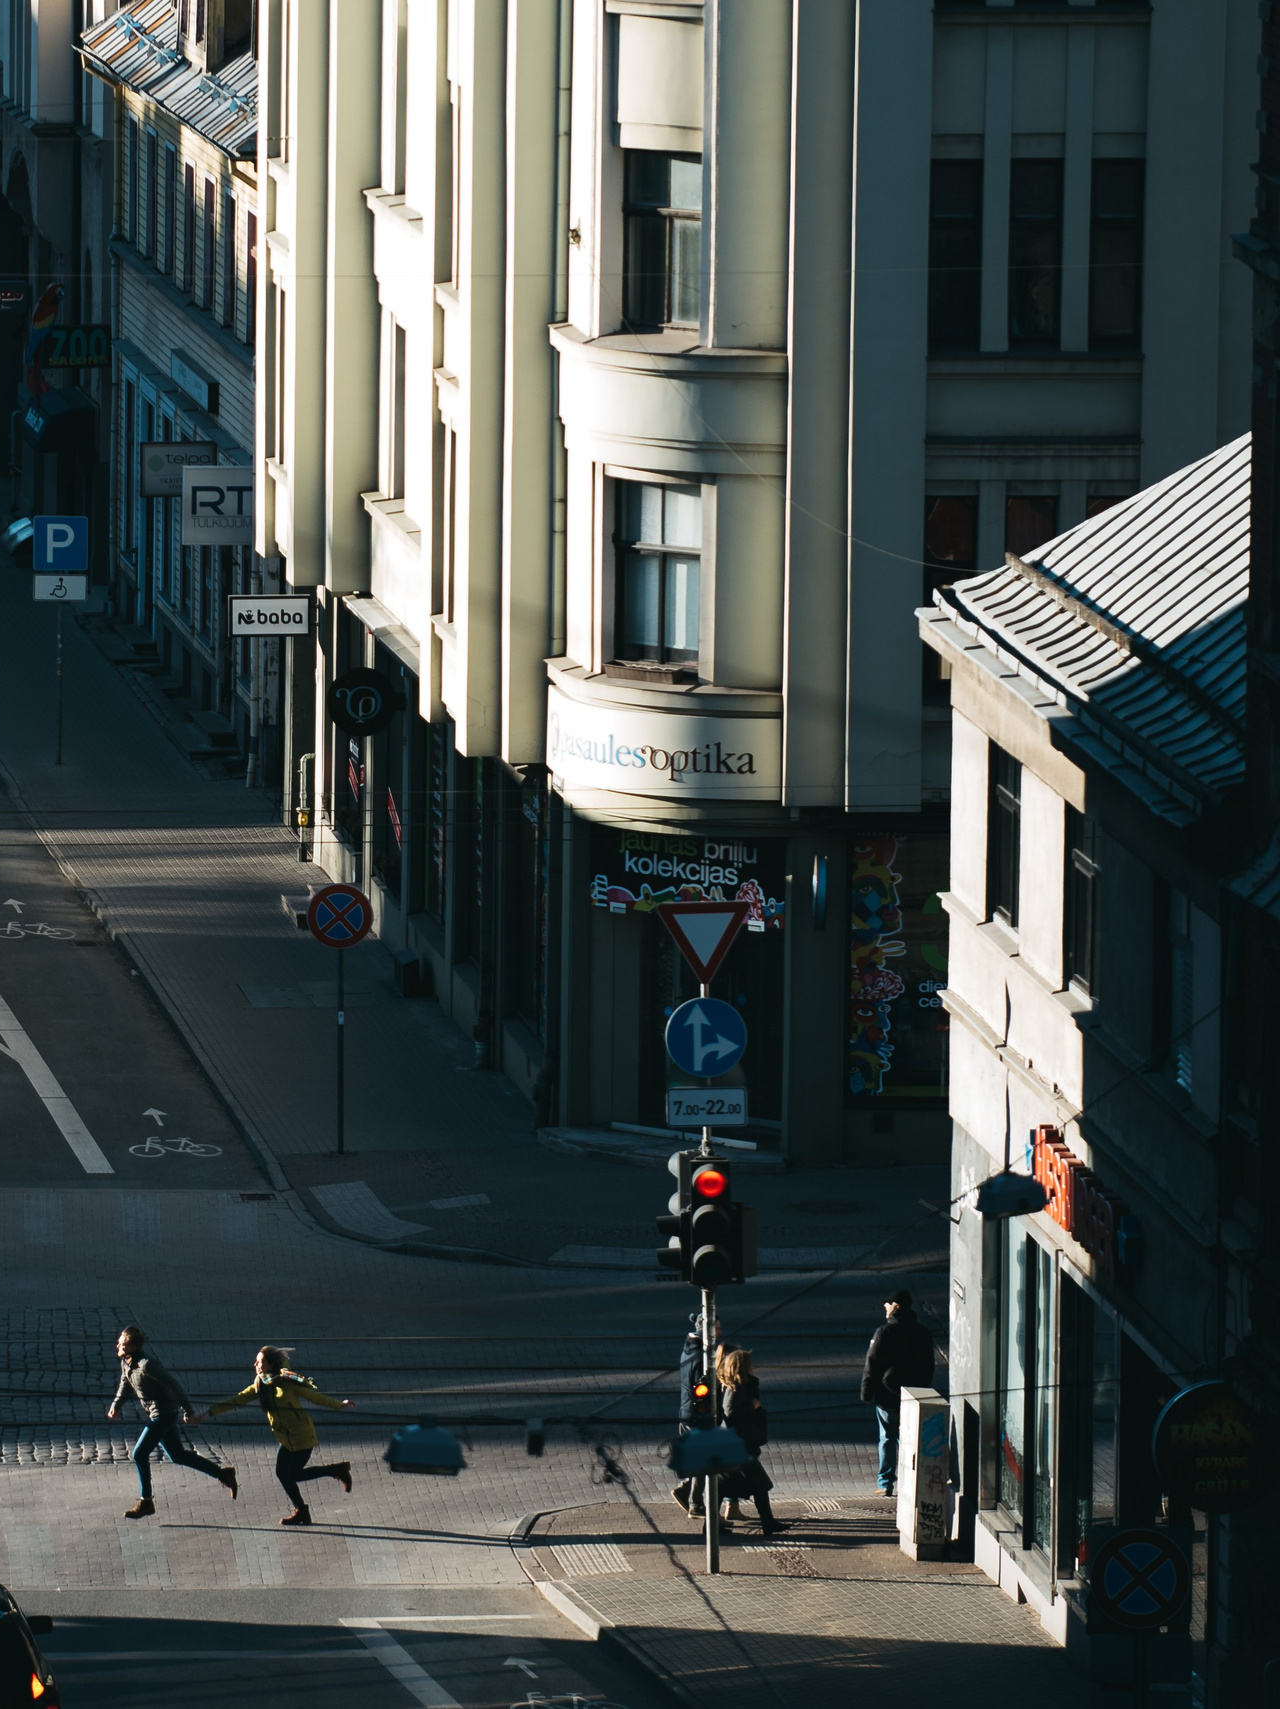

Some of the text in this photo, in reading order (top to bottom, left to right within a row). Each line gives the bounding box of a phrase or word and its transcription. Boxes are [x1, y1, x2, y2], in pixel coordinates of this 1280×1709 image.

[51, 328, 108, 363] ZOO
[164, 453, 211, 466] telpa
[46, 523, 75, 563] P
[625, 850, 739, 887] kolekcijas
[918, 997, 943, 1008] ce
[672, 1099, 742, 1116] 7.00-22.00
